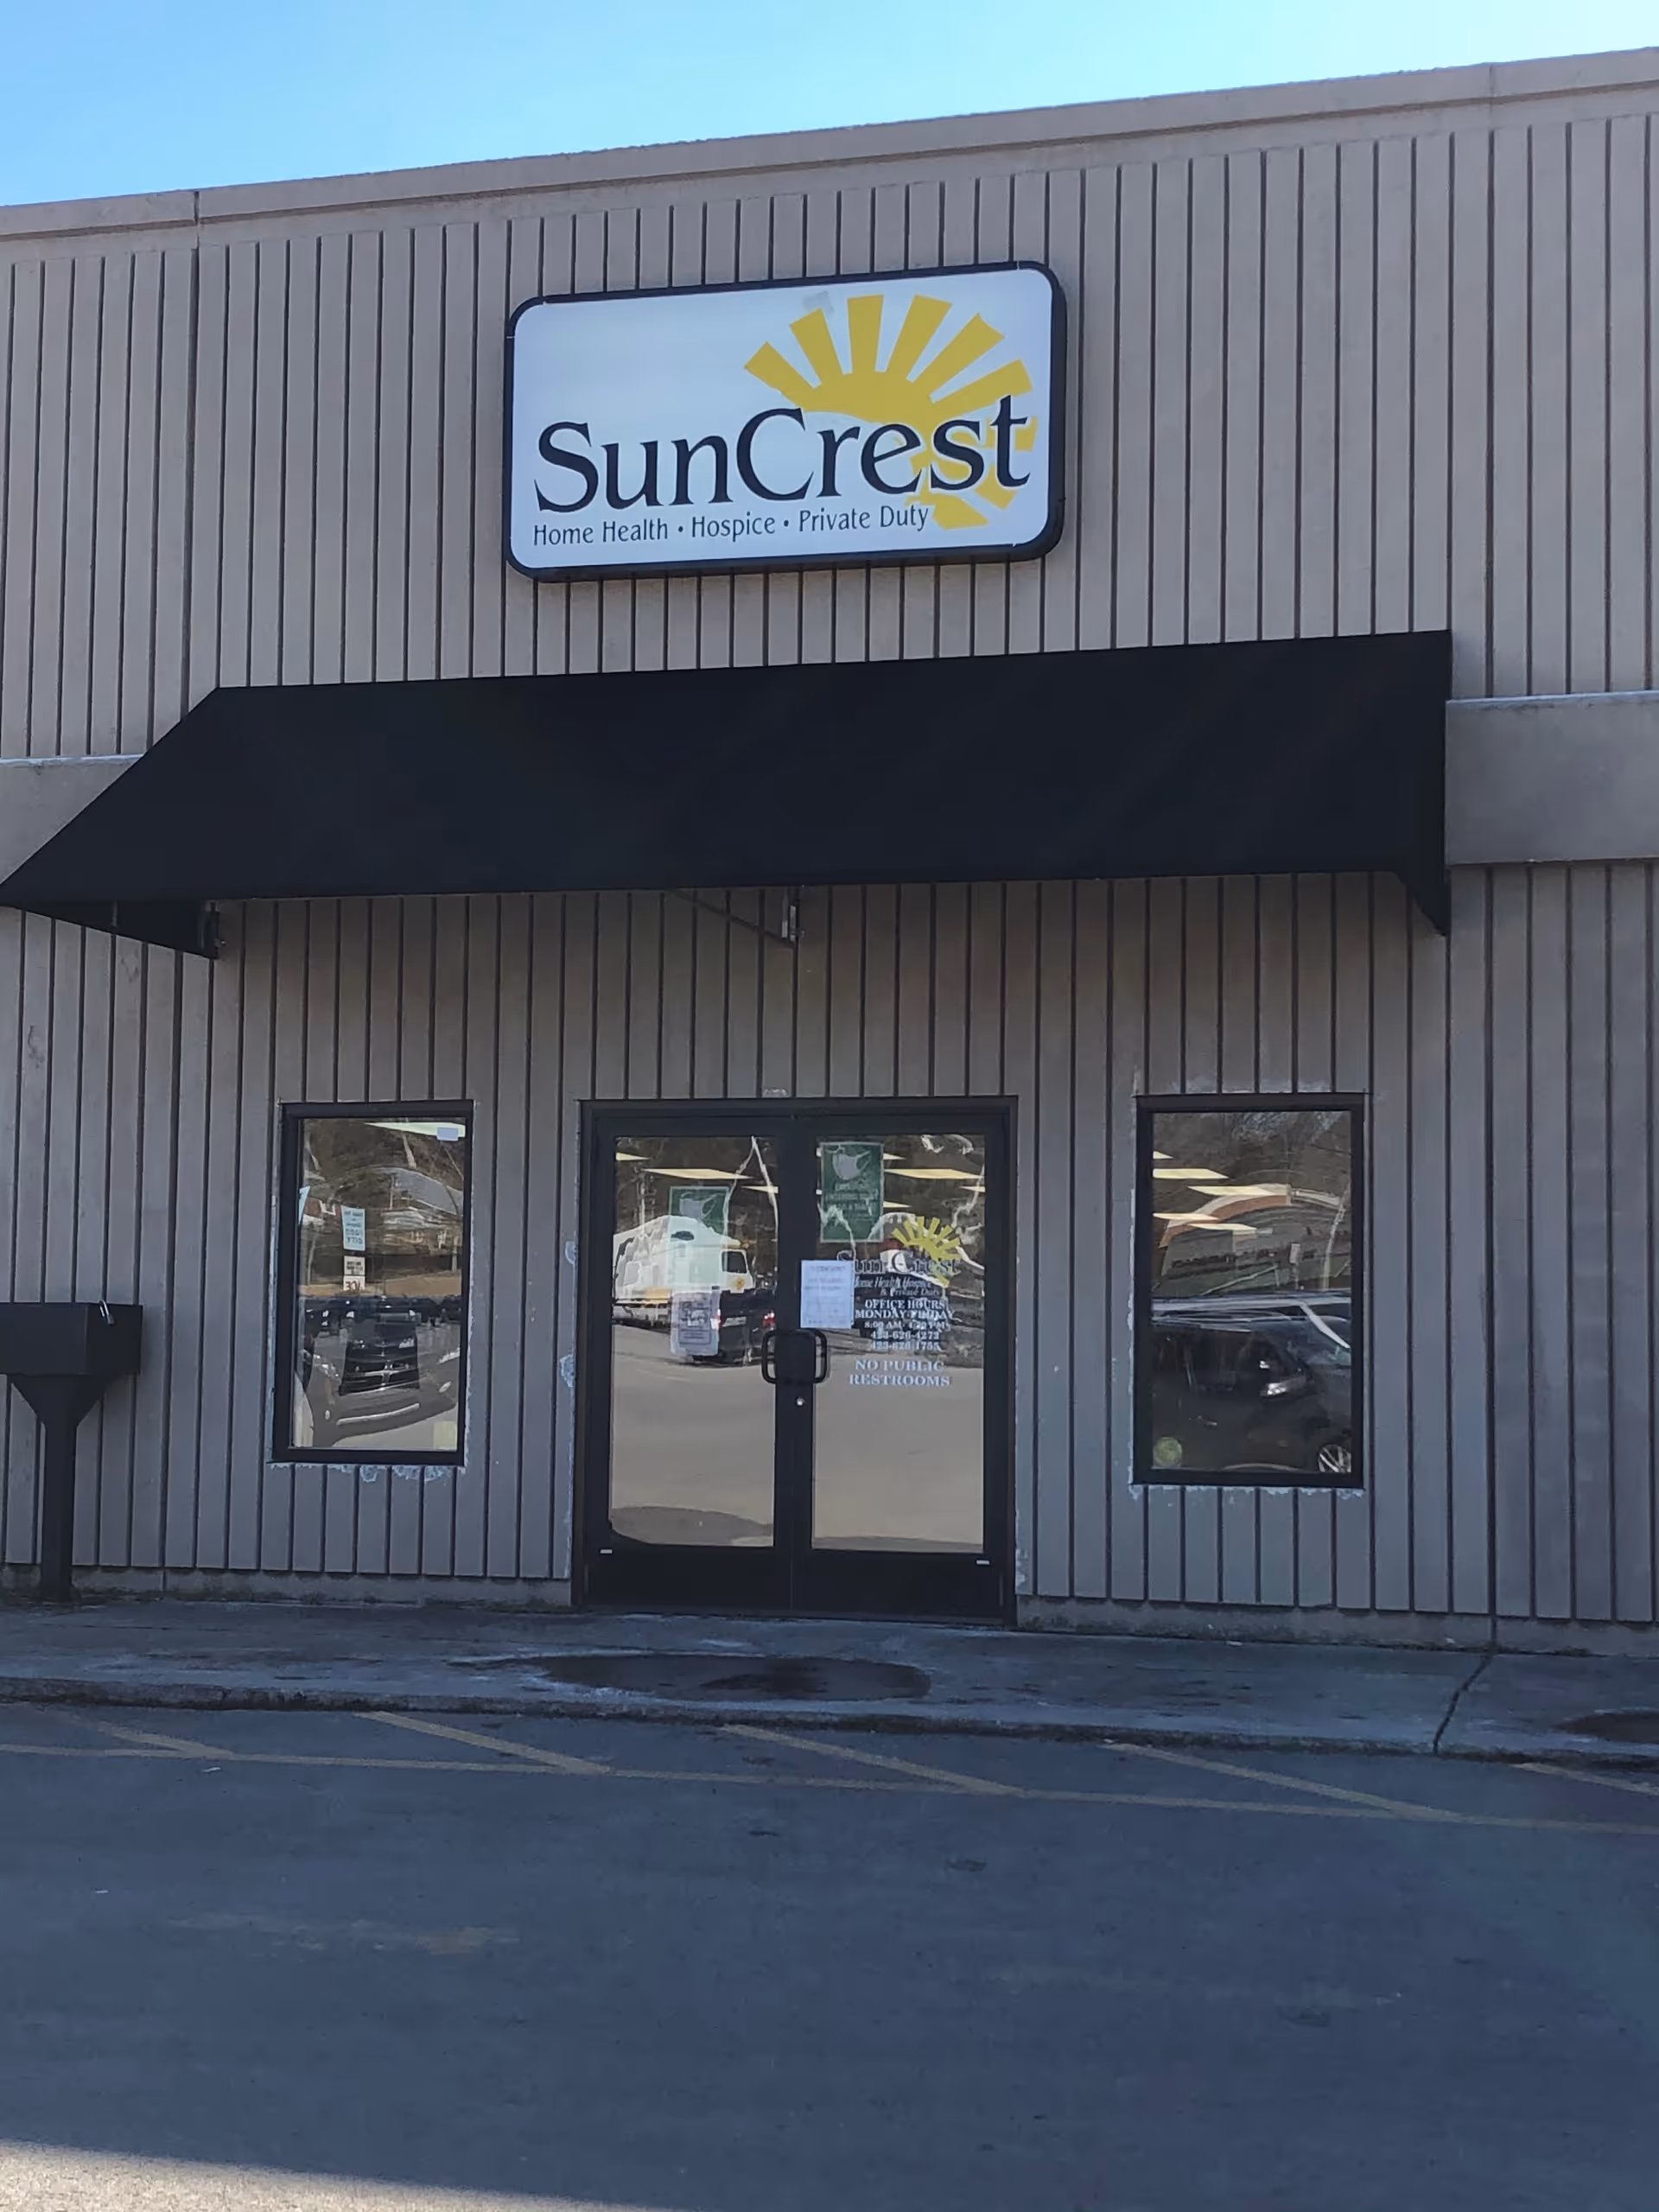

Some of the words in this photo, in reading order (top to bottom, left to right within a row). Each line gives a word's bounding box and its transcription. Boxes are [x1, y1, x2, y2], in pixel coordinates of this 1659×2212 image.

[533, 394, 1032, 513] SunCrest
[533, 524, 594, 546] Home
[602, 518, 669, 543] Health
[691, 510, 776, 543] Hospice
[798, 506, 871, 532] Private
[880, 504, 929, 532] Duty
[865, 1299, 905, 1309] OFFICE
[907, 1299, 945, 1310] HOURS
[855, 1360, 878, 1370] NO
[883, 1360, 944, 1371] PUBLIC
[849, 1374, 950, 1386] RESTROOMS
